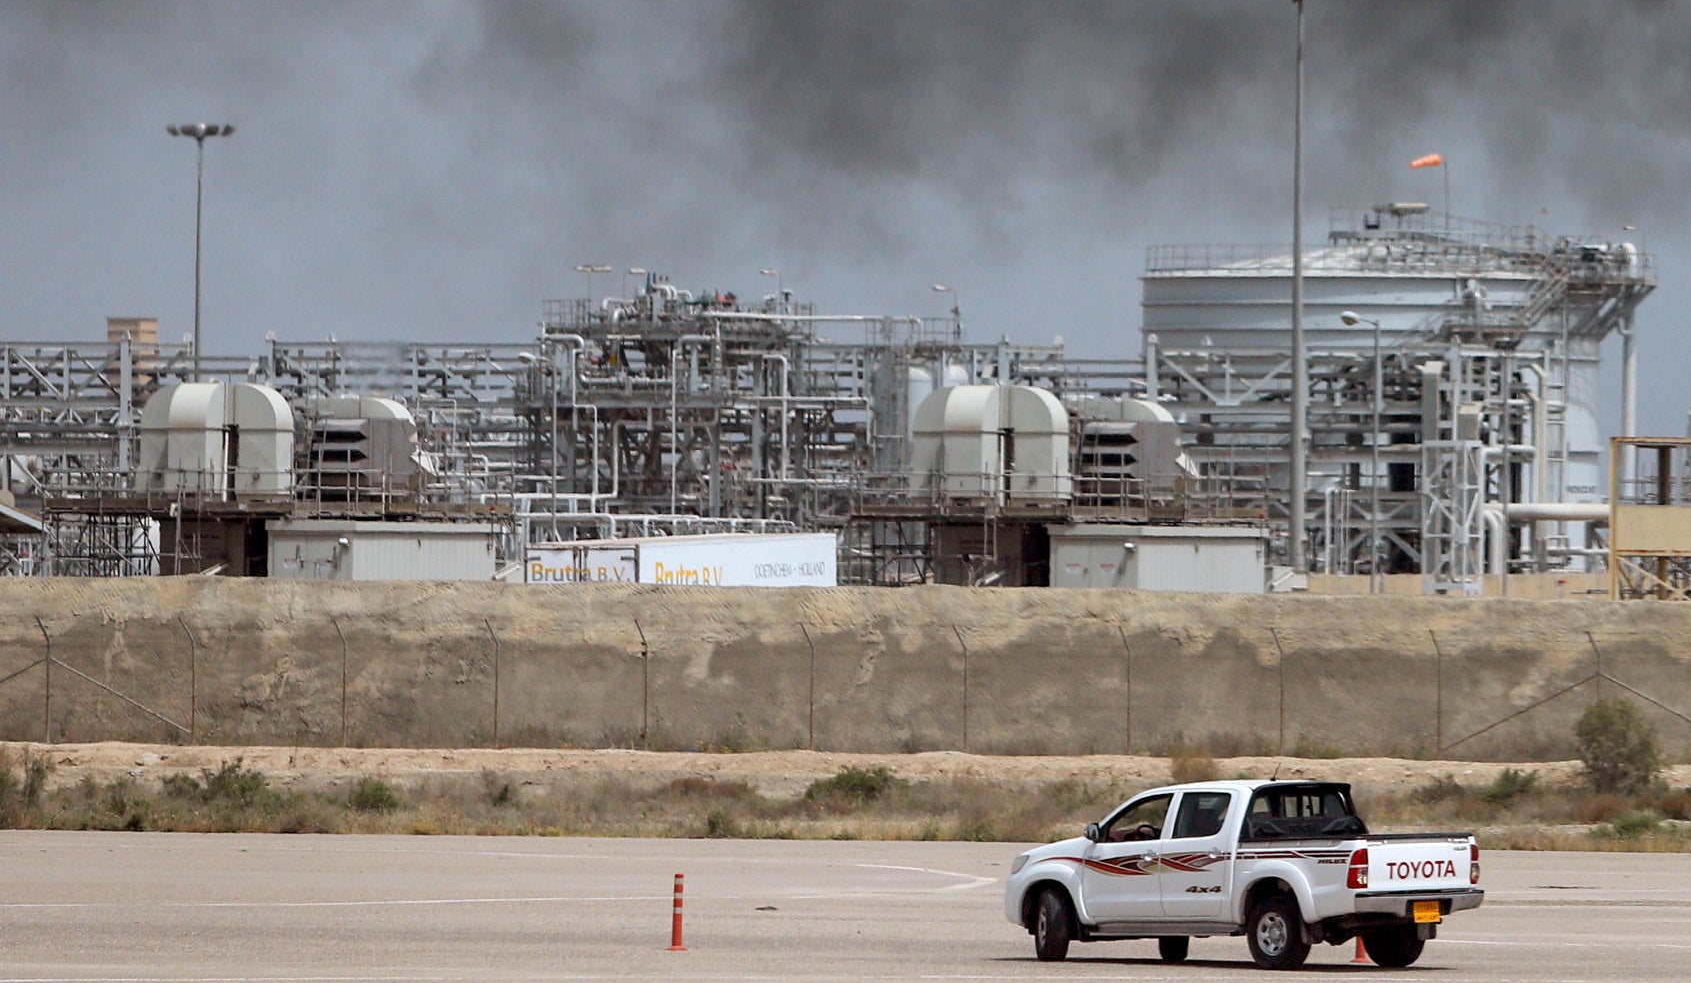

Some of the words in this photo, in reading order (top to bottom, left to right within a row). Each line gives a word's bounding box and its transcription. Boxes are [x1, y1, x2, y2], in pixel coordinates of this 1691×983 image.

[531, 562, 591, 581] Brutra
[597, 566, 631, 581] B.V.
[1386, 860, 1457, 880] TOYOTA
[1185, 885, 1222, 894] 4x4
